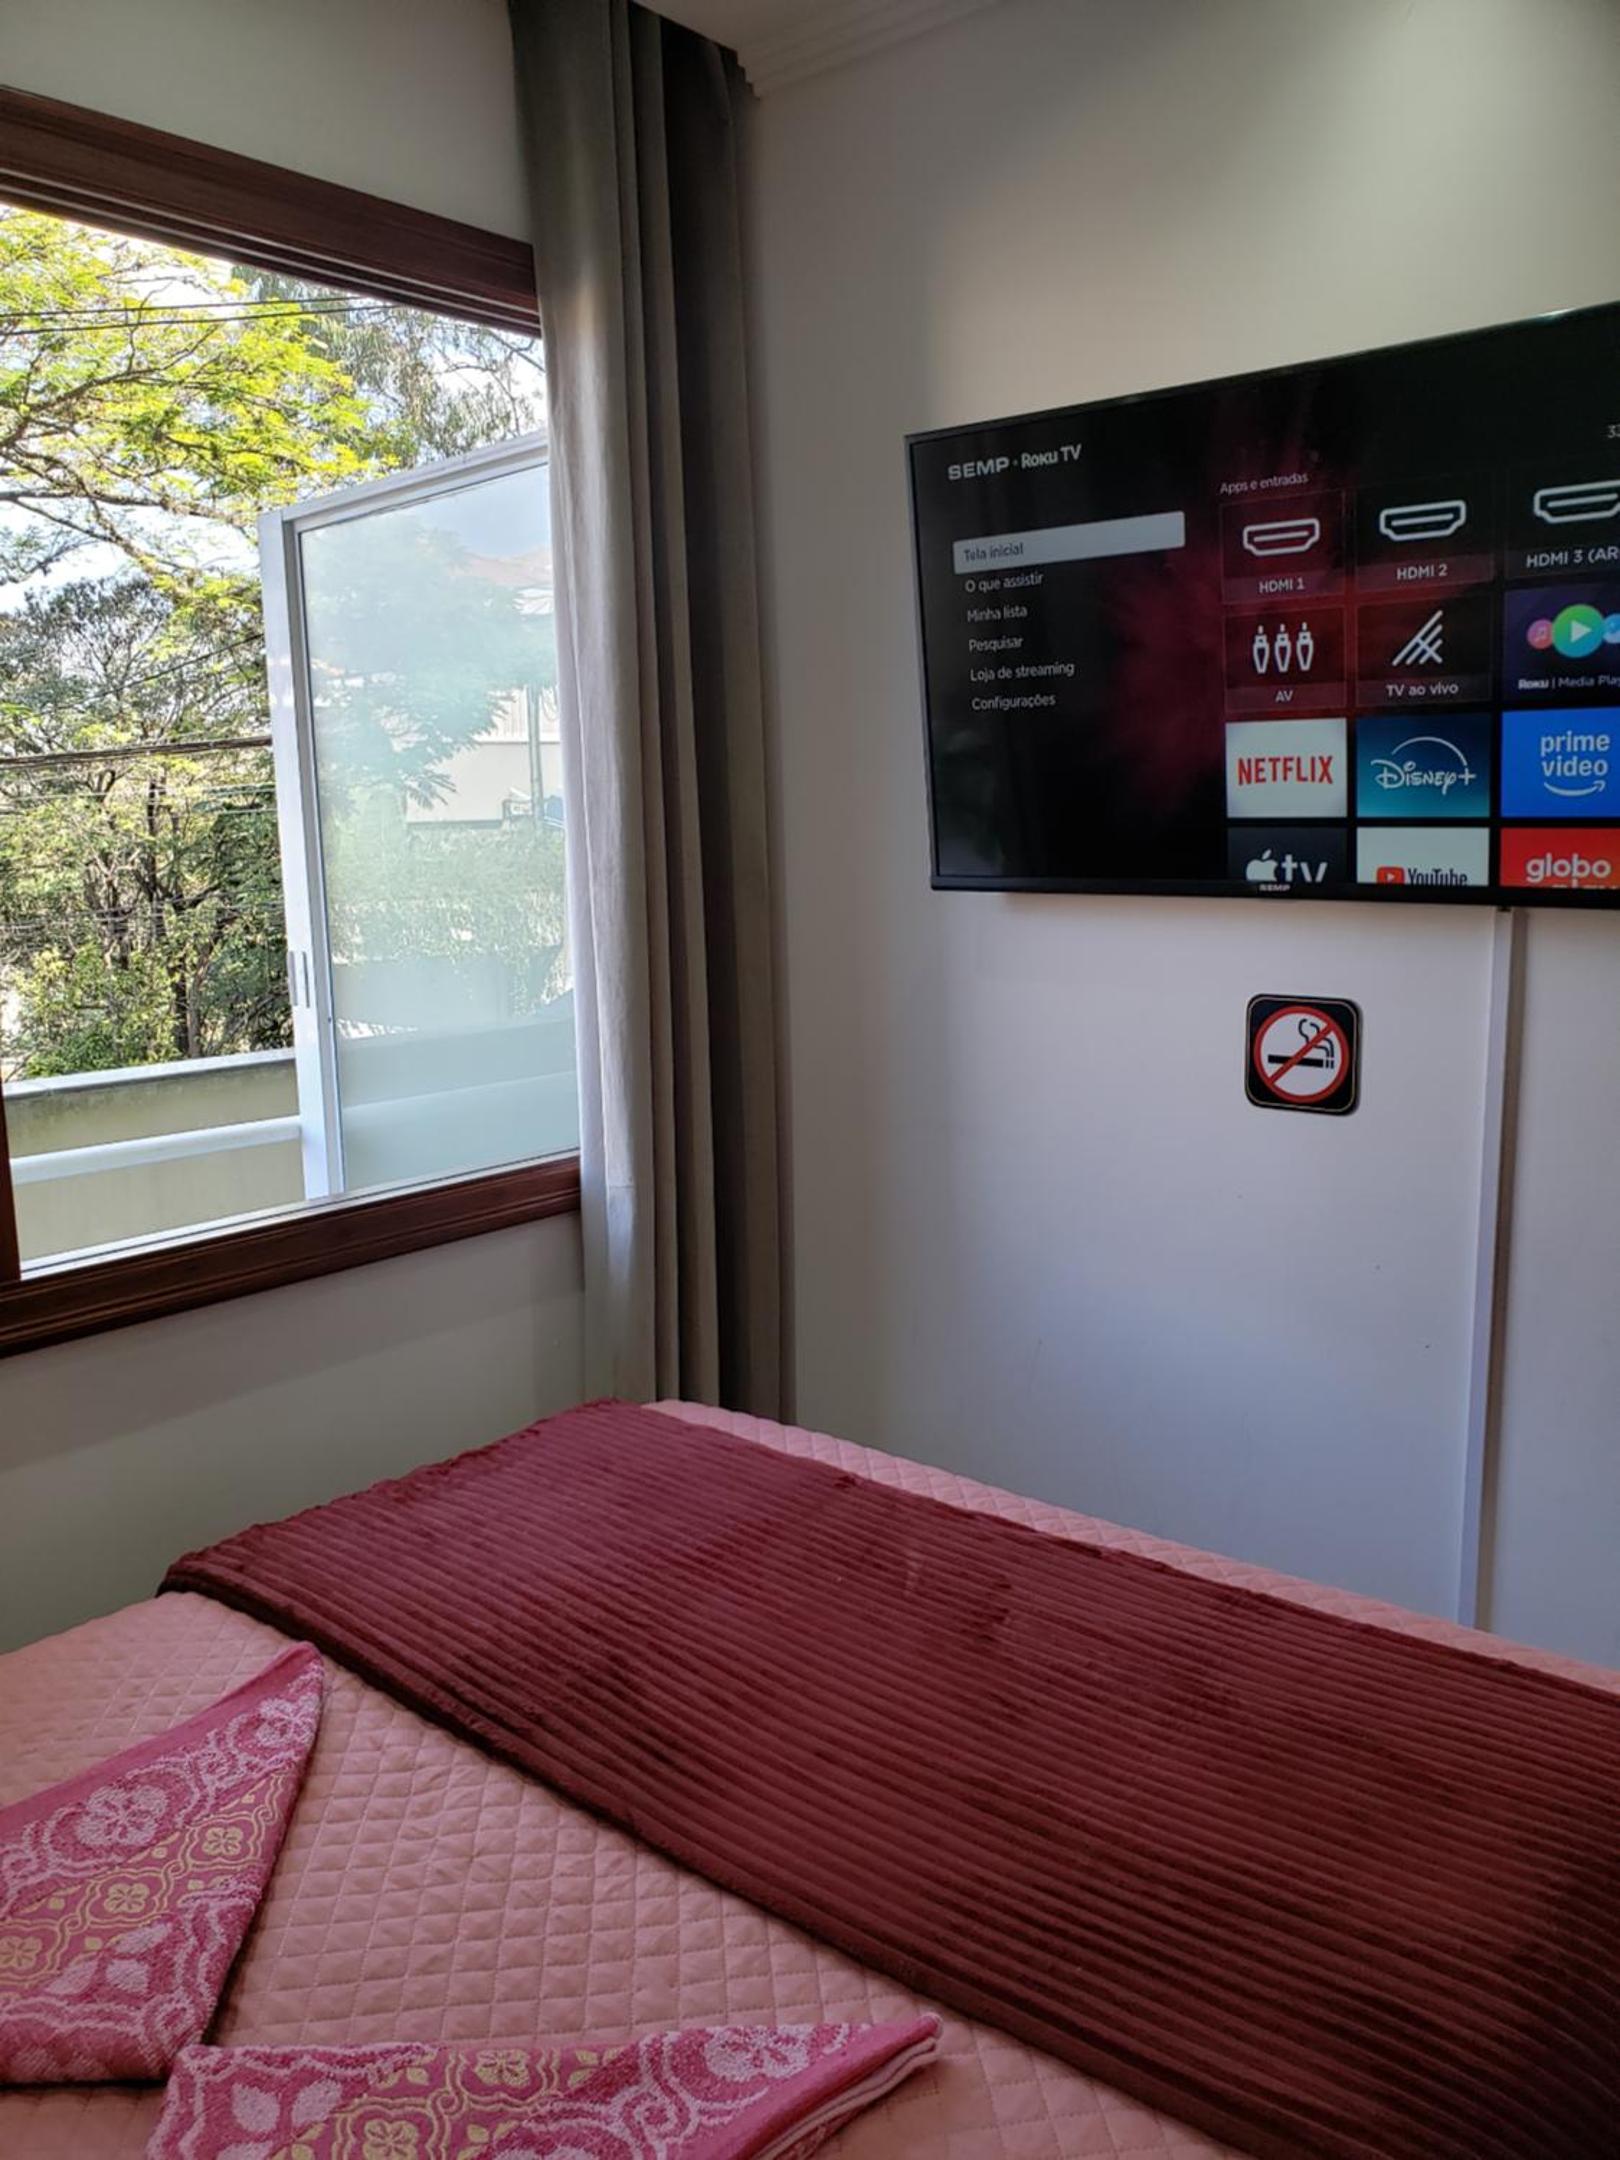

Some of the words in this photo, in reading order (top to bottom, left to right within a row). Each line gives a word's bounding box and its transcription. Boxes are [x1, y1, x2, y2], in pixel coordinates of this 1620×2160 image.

[948, 457, 1010, 480] SEMP
[1060, 443, 1082, 461] TV
[1220, 482, 1249, 495] Apps
[1250, 480, 1259, 490] e
[1260, 472, 1309, 488] entradas
[964, 549, 987, 561] Tela
[990, 542, 1024, 558] inicial
[1527, 550, 1569, 569] HDMI
[1573, 550, 1584, 563] 3
[1397, 564, 1435, 580] HDMI
[1438, 563, 1449, 577] 2
[965, 580, 976, 593] O
[978, 578, 1001, 593] que
[1003, 571, 1044, 588] assistir
[1258, 578, 1294, 593] HDMI
[1296, 577, 1306, 590] 1
[967, 607, 1001, 622] Minha
[1003, 604, 1028, 619] lista
[968, 636, 1024, 652] Pesquisar
[970, 667, 996, 683] Loja
[997, 665, 1013, 679] de
[1015, 661, 1075, 678] streaming
[1386, 684, 1405, 697] TV
[1408, 685, 1426, 695] ao
[1430, 681, 1459, 695] vivo
[1558, 676, 1595, 688] Media
[971, 694, 1057, 711] Configurações
[1275, 690, 1294, 703] AV
[1540, 730, 1611, 758] prime
[1238, 755, 1333, 786] NETFLIX
[1541, 755, 1609, 777] video
[1281, 854, 1328, 883] tv
[1526, 852, 1612, 884] globo
